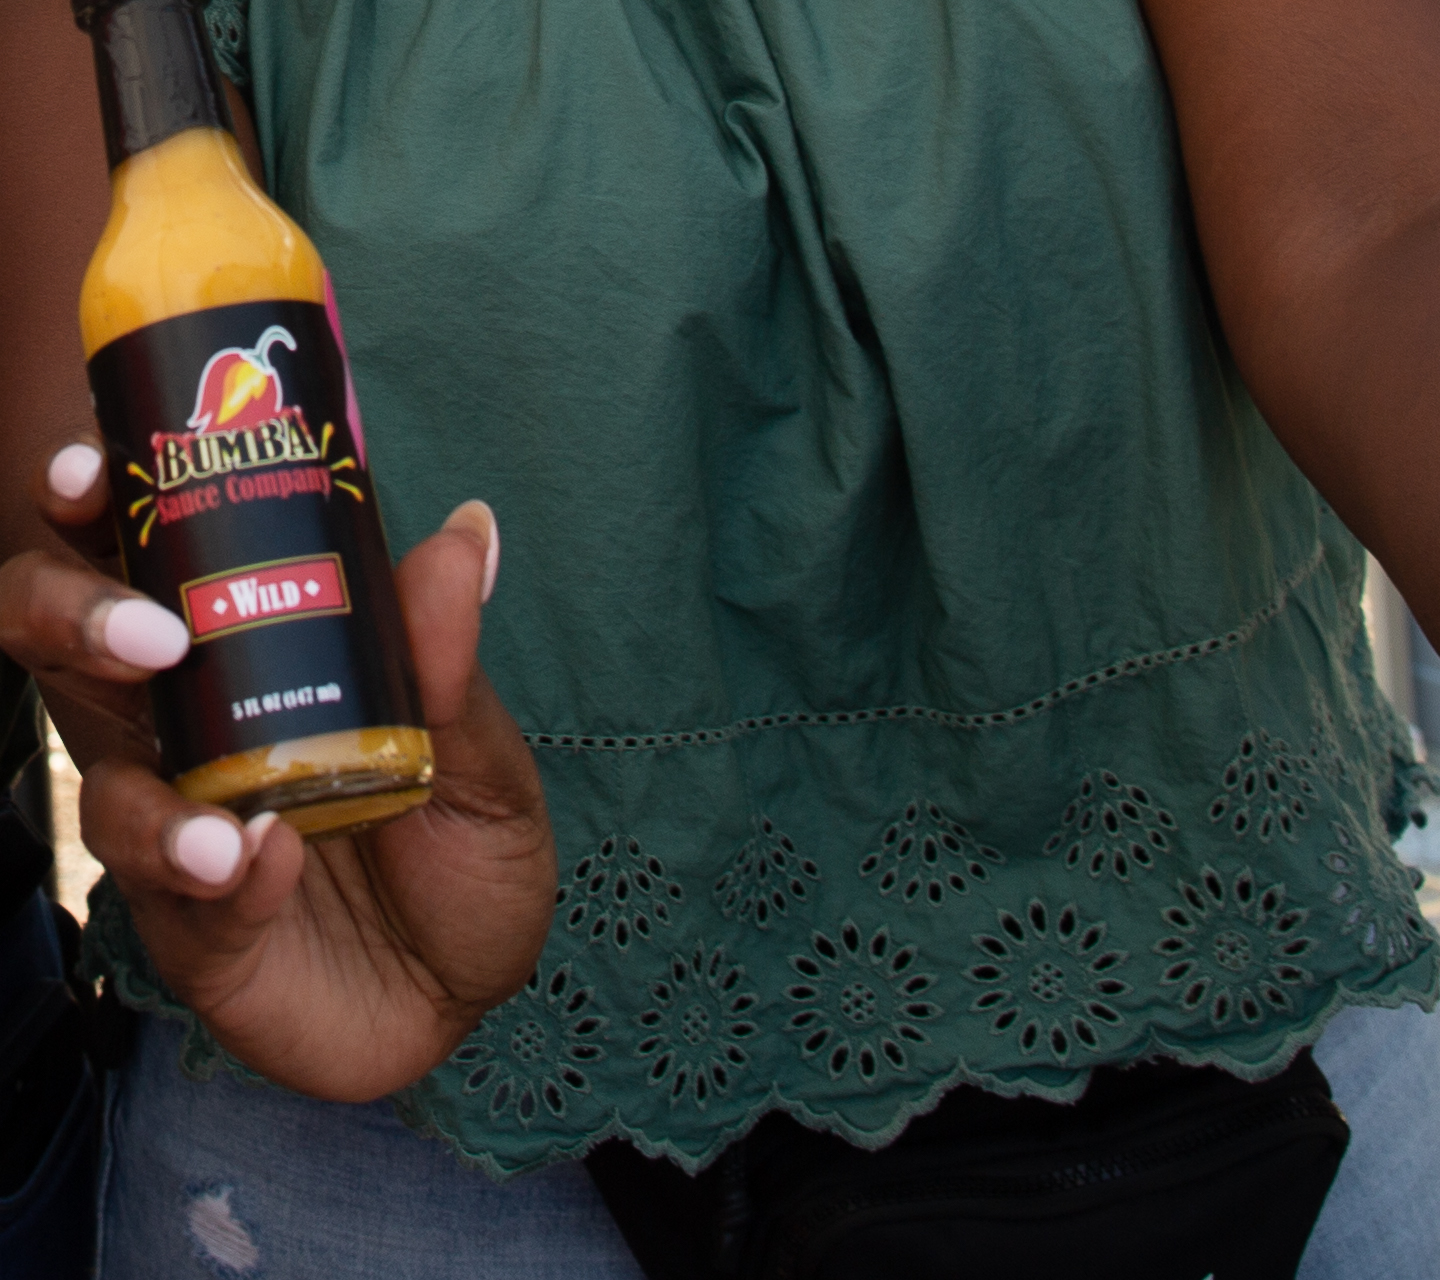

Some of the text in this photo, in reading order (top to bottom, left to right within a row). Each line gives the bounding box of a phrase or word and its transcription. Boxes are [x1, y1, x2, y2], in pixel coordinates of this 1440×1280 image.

[152, 406, 319, 490] BUMBA
[225, 465, 332, 504] Company
[231, 700, 244, 721] 5
